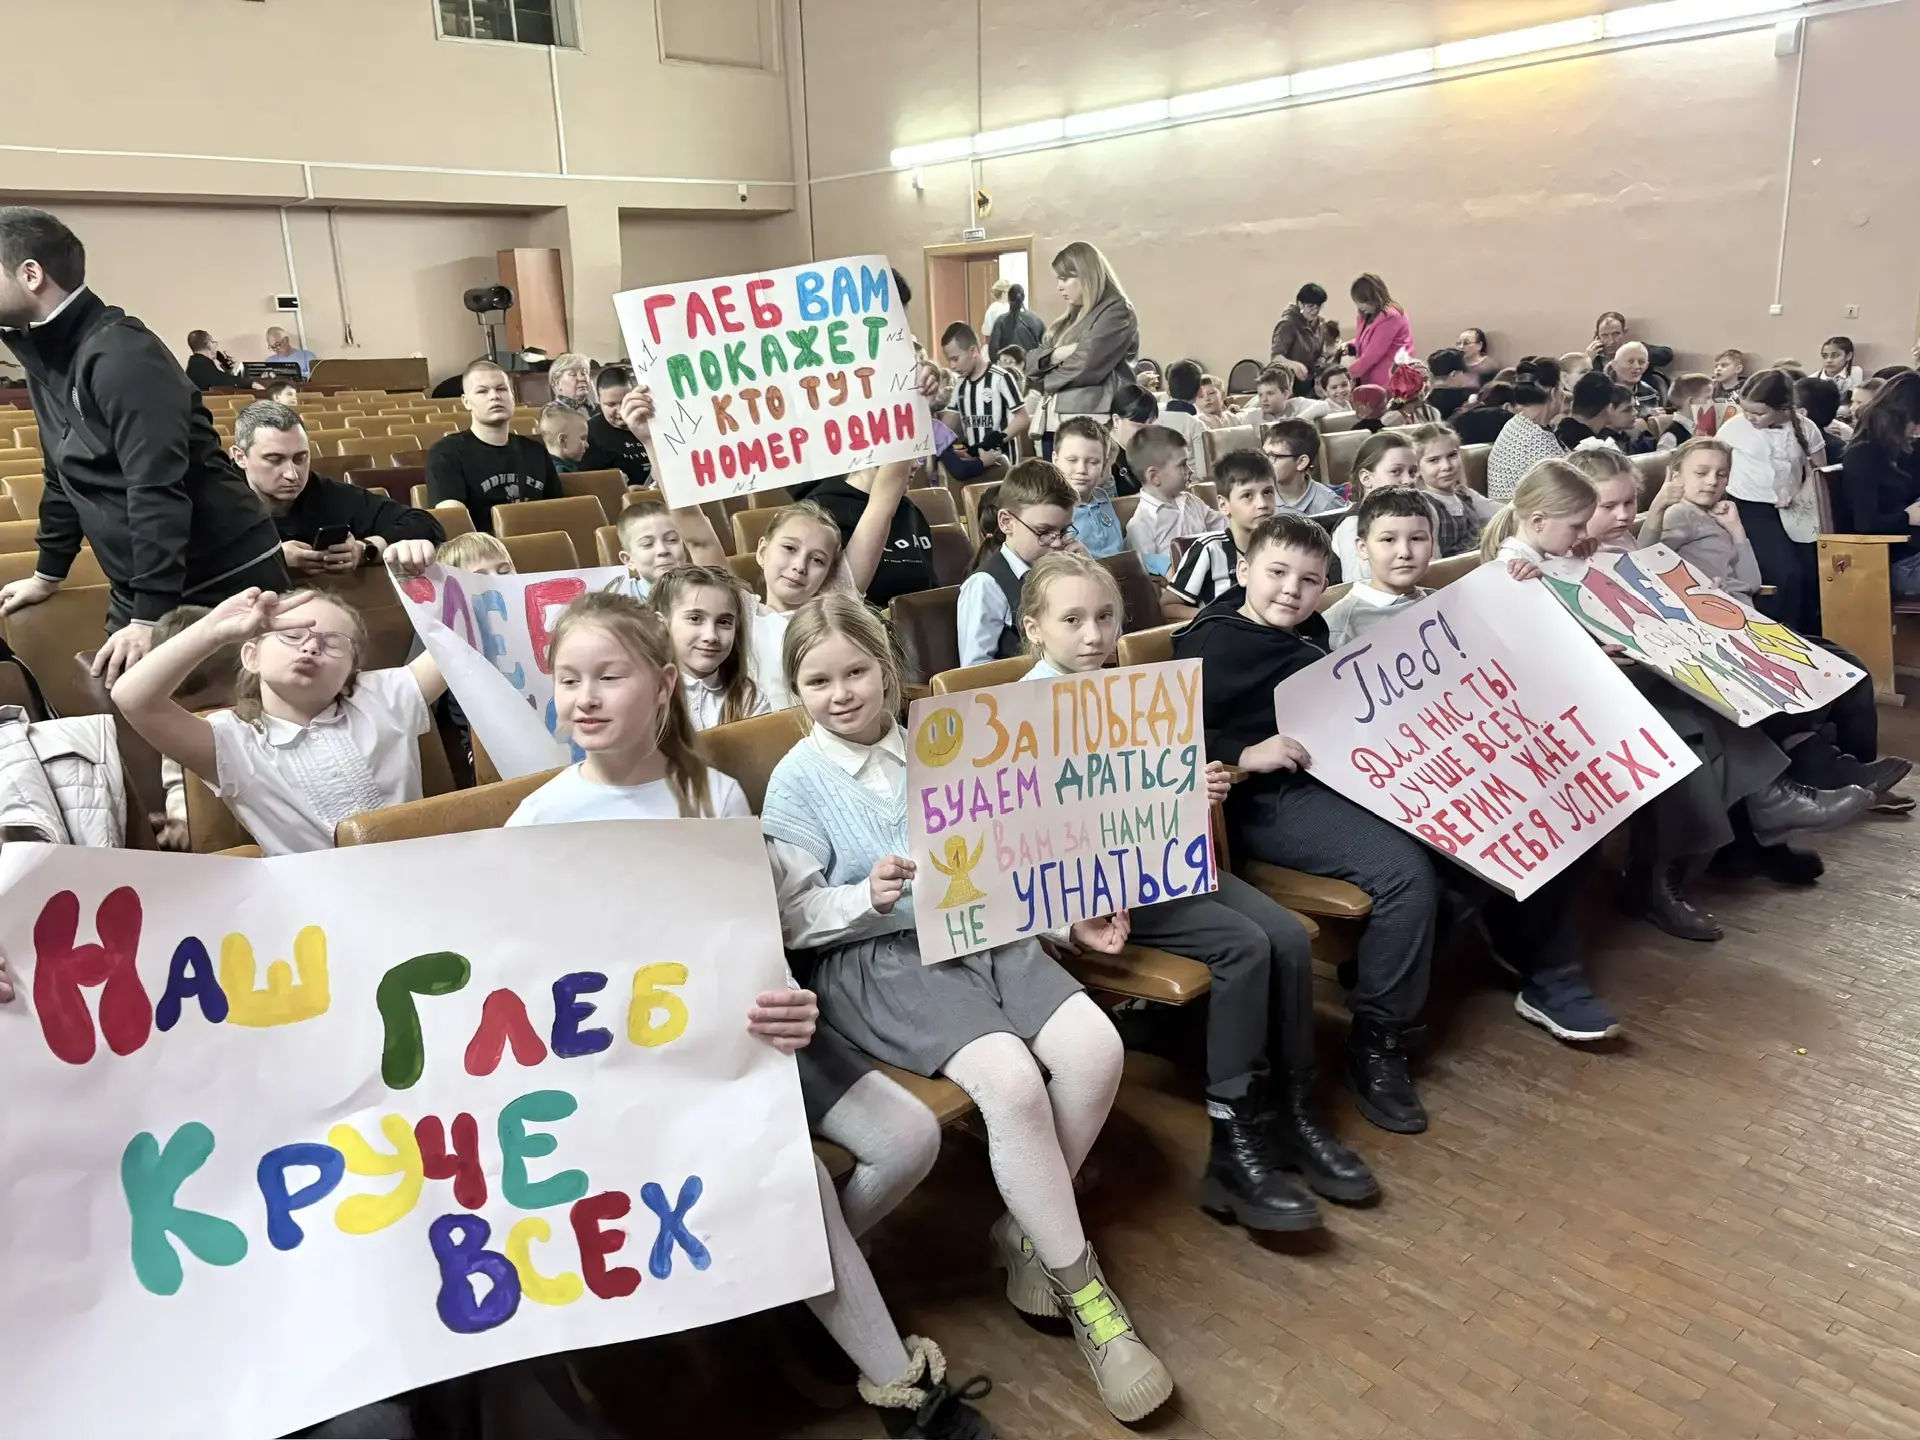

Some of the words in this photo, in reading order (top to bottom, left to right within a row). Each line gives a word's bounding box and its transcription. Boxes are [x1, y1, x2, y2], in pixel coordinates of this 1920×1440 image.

[643, 279, 783, 345] ГЛЕБ
[795, 265, 889, 322] ВАМ
[666, 316, 888, 400] ПОКАЖЕТ
[711, 385, 786, 435] КТО
[799, 366, 876, 411] ТУТ
[690, 427, 809, 487] НОМЕР
[824, 402, 916, 455] ОДИН
[1052, 665, 1201, 756] ПОБЕДУ
[1332, 610, 1468, 724] Глеб!
[1417, 691, 1474, 741] НАС
[1459, 658, 1518, 708] ТЫ
[920, 765, 1042, 834] БУДЕМ
[1054, 744, 1198, 805] ДРАТЬСЯ
[1396, 746, 1476, 823] ЛУЧШЕ
[1462, 699, 1538, 764] ВСЕХ
[1479, 808, 1565, 880] ТЕБЯ
[1550, 726, 1676, 832] УСПЕХ!
[992, 819, 1054, 872] ВАМ
[1063, 820, 1091, 852] ЗА
[1100, 798, 1178, 848] НАМИ
[1415, 773, 1528, 855] ВЕРИМ
[945, 904, 988, 954] НЕ
[1012, 808, 1217, 932] УГНАТЬСЯ!
[121, 1088, 590, 1297] КРУЧЕ
[428, 1174, 712, 1335] ВСЕХ
